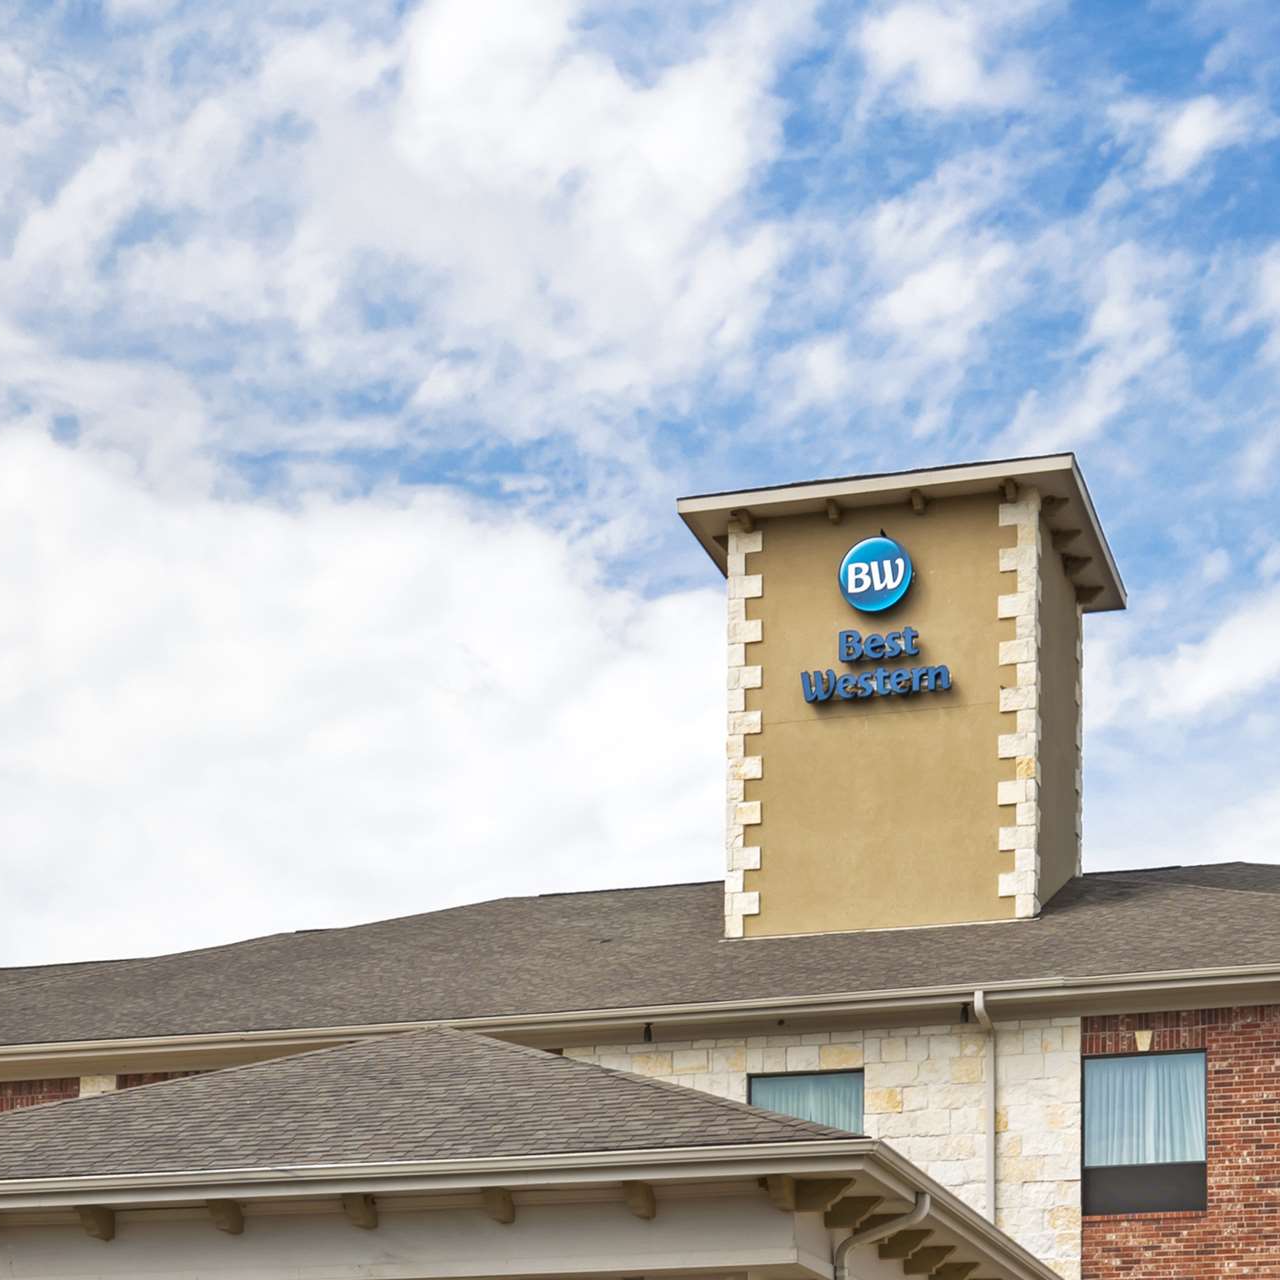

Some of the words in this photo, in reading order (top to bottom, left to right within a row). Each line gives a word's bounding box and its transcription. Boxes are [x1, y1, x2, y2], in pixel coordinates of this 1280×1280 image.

[847, 557, 905, 594] BW
[838, 626, 920, 663] Best
[800, 664, 952, 704] Western
